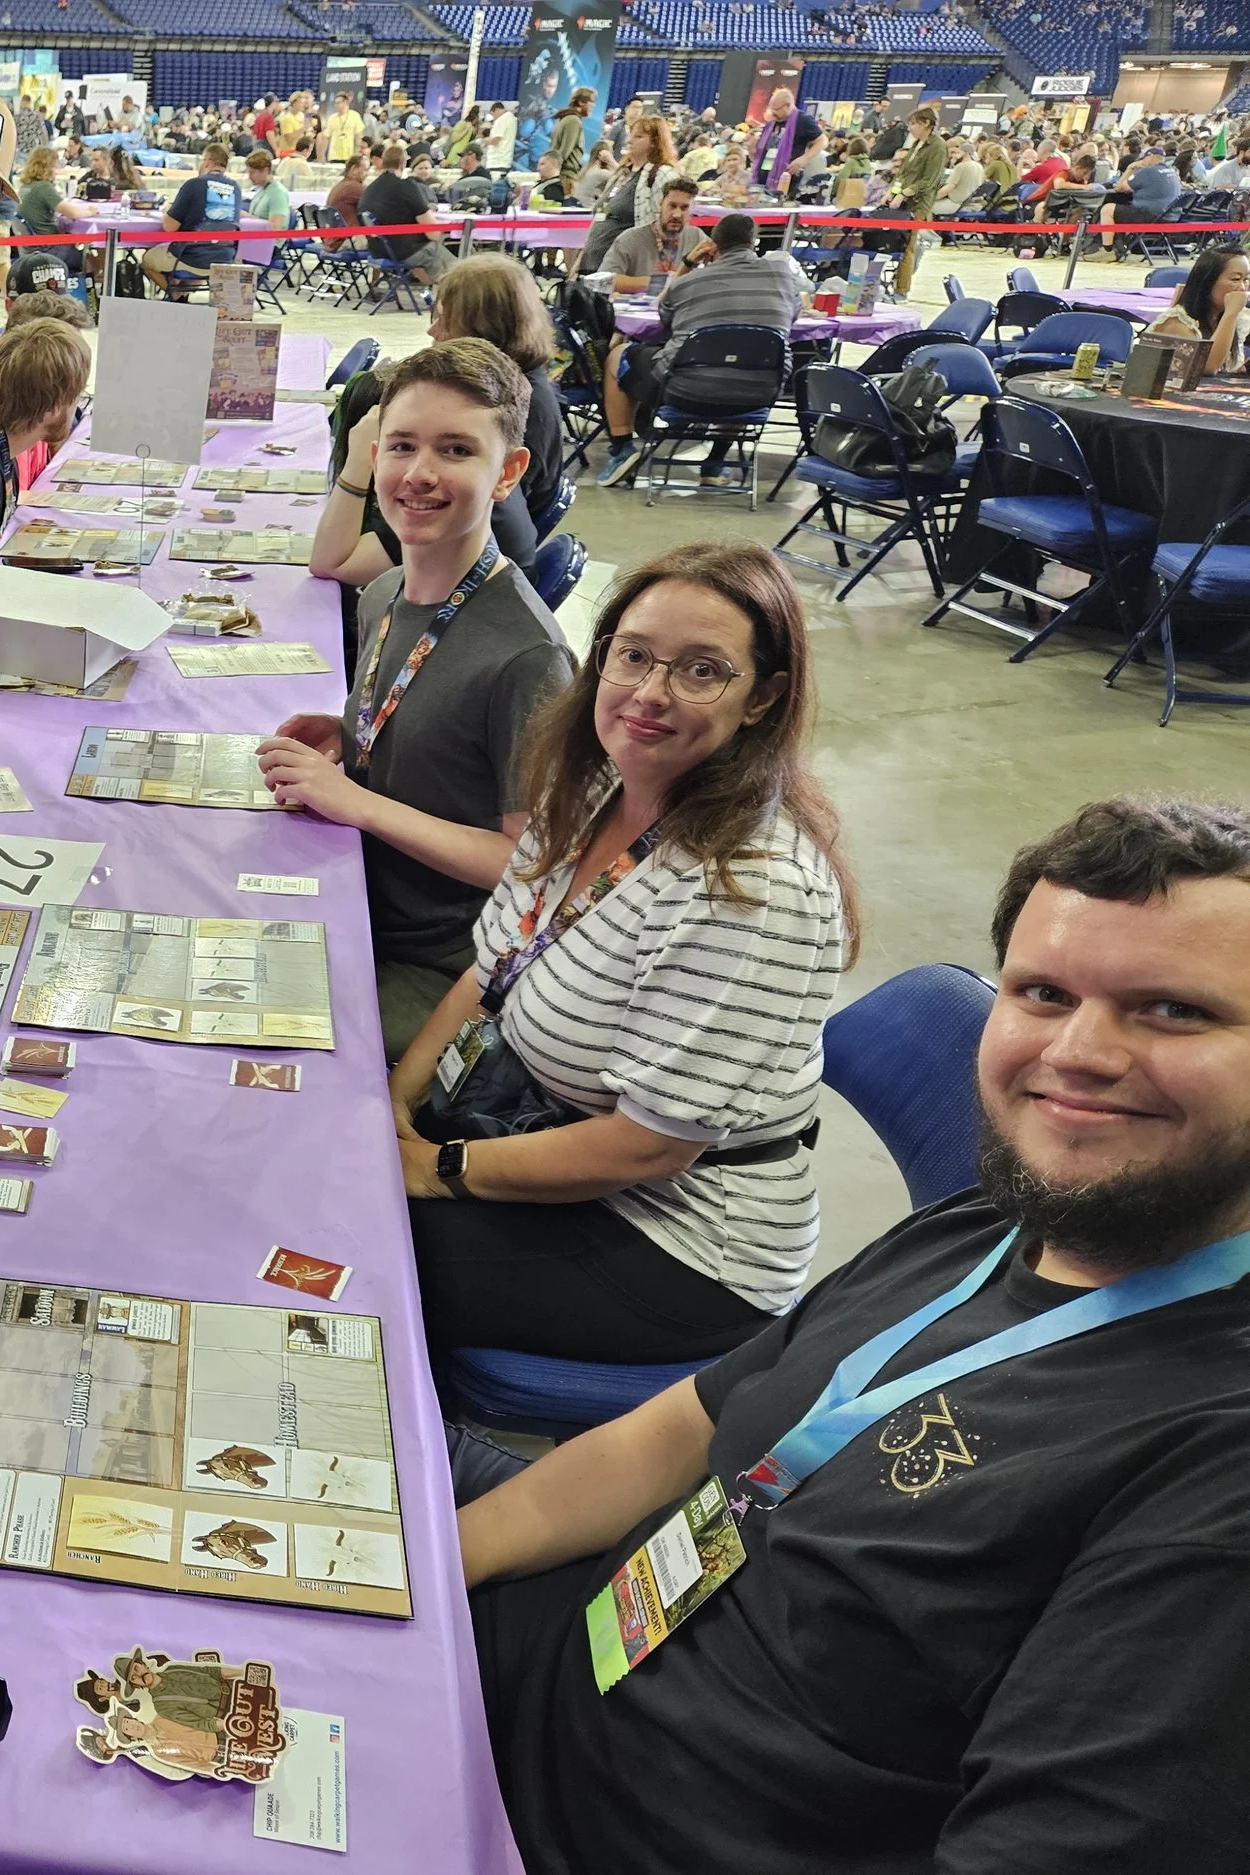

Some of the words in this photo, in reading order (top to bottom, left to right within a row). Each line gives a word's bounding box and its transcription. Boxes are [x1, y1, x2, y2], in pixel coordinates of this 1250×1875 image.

[36, 931, 60, 959] ABILENE
[30, 1288, 55, 1327] SALOON
[97, 1323, 126, 1334] LAWMAN
[63, 1371, 93, 1430] BUILDINGS
[274, 1380, 297, 1450] HOMESTEAD
[13, 1513, 25, 1533] PHASE
[689, 1500, 704, 1529] 4-Day
[8, 1532, 21, 1560] RANCHER
[67, 1551, 102, 1564] RANCHER
[185, 1567, 209, 1579] HAND
[211, 1570, 237, 1582] HIRED
[635, 1557, 645, 1577] NEW
[295, 1580, 320, 1592] HAND
[321, 1583, 349, 1595] HIRED
[639, 1576, 663, 1637] ACHIEVEMENT!
[227, 1683, 255, 1737] OUT
[267, 1792, 275, 1819] QUAADE
